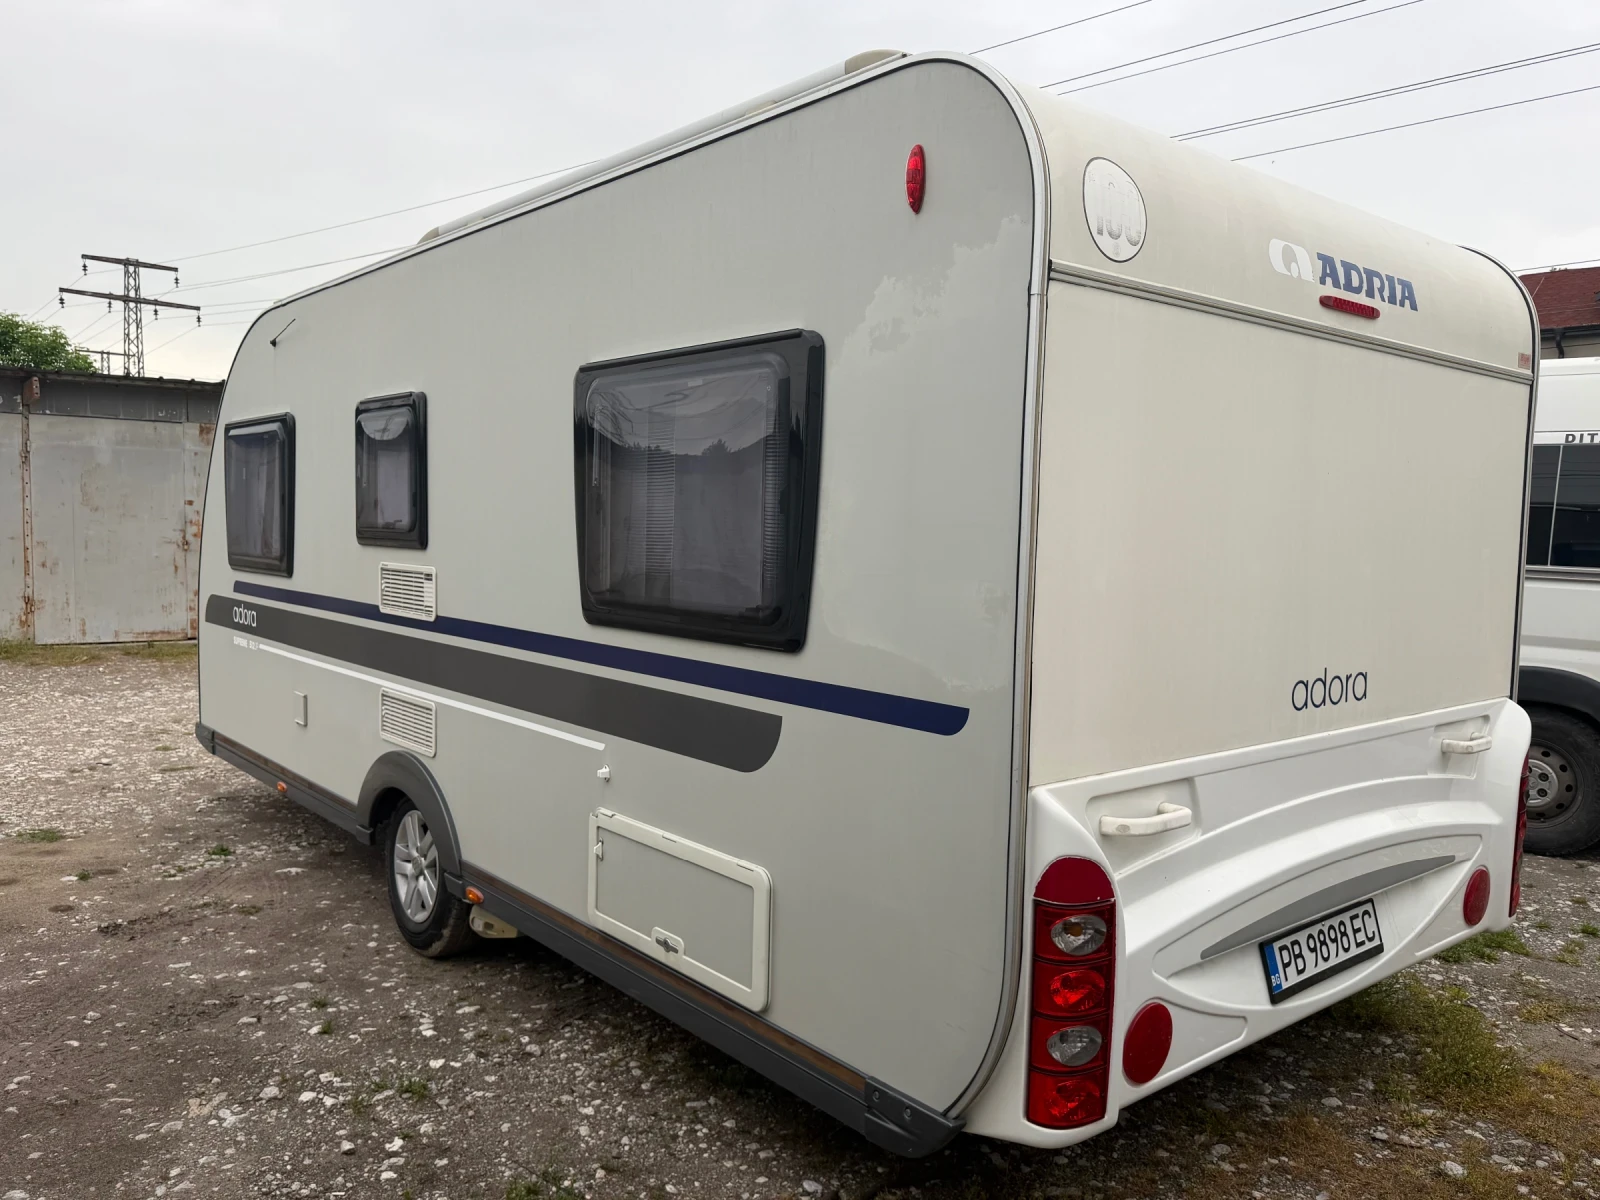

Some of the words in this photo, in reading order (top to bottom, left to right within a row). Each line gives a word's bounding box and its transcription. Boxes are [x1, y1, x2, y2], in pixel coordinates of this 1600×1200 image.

[1316, 252, 1419, 312] ADRIA
[1564, 433, 1600, 444] DIT
[232, 603, 257, 628] adora
[1291, 667, 1368, 712] adora
[1278, 939, 1307, 982] PB
[1306, 920, 1351, 969] 9898
[1349, 909, 1376, 949] EC
[1271, 973, 1281, 987] BG
